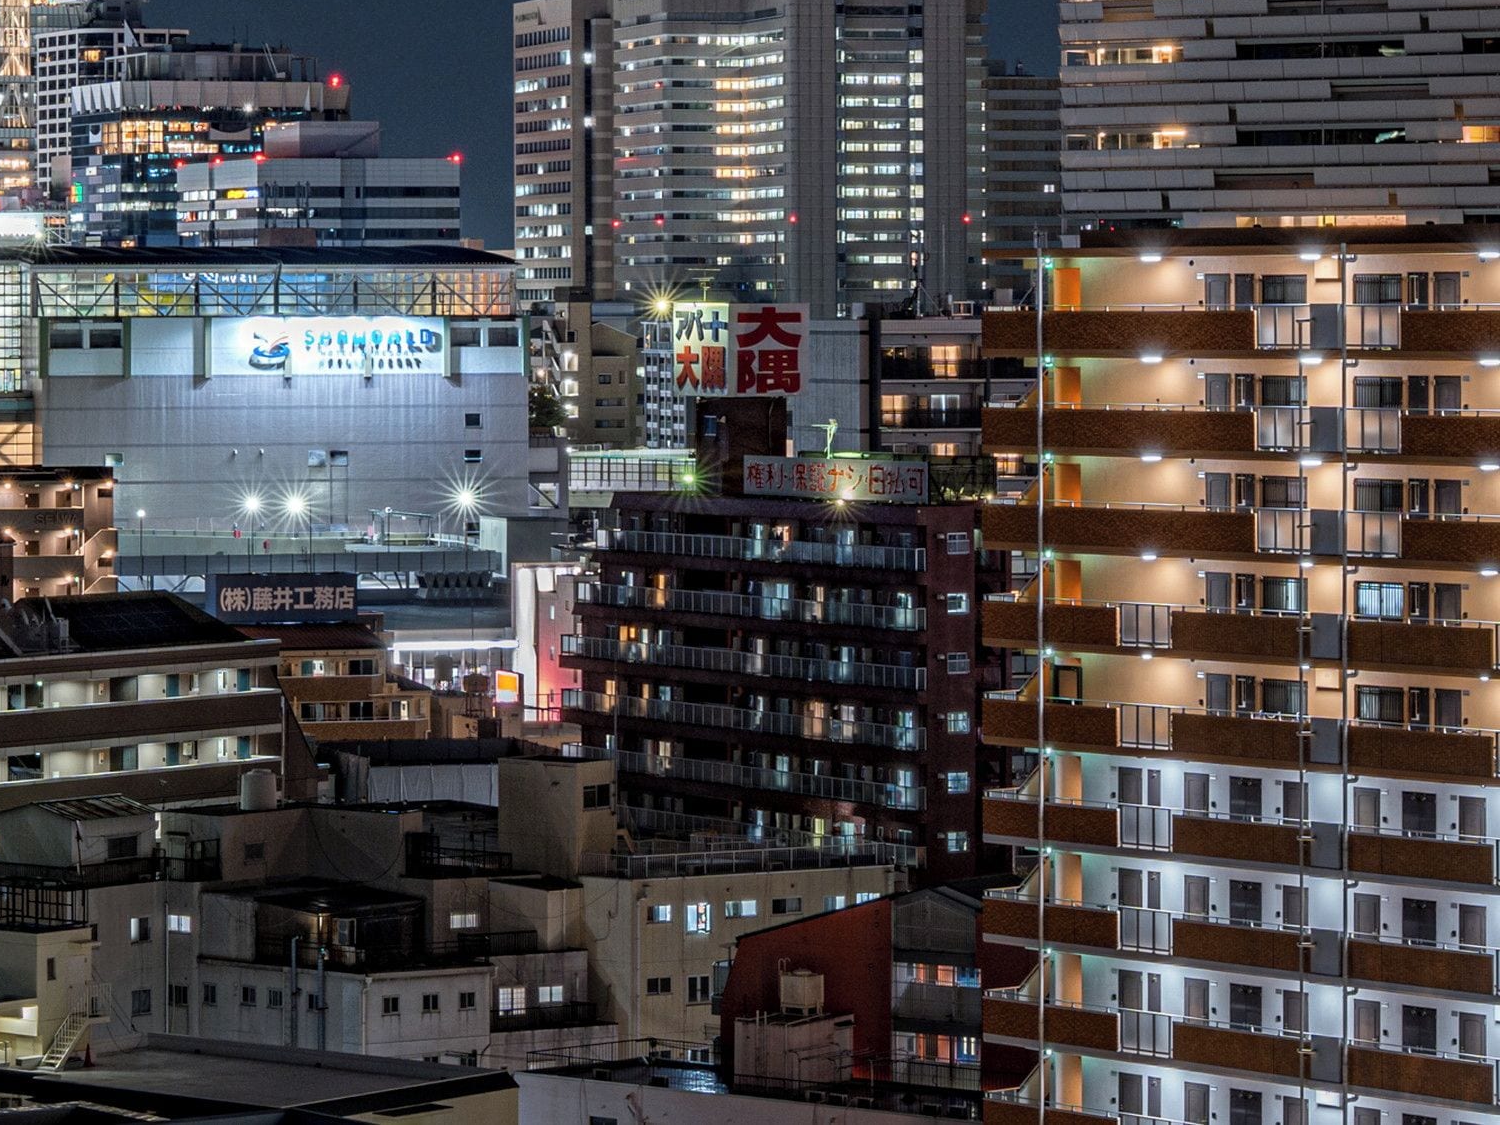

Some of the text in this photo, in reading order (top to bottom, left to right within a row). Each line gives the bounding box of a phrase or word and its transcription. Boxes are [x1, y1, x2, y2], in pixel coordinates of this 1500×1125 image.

[676, 345, 726, 392] 大隅
[736, 306, 802, 394] 大隅
[219, 586, 356, 612] (株)藤井工務店
